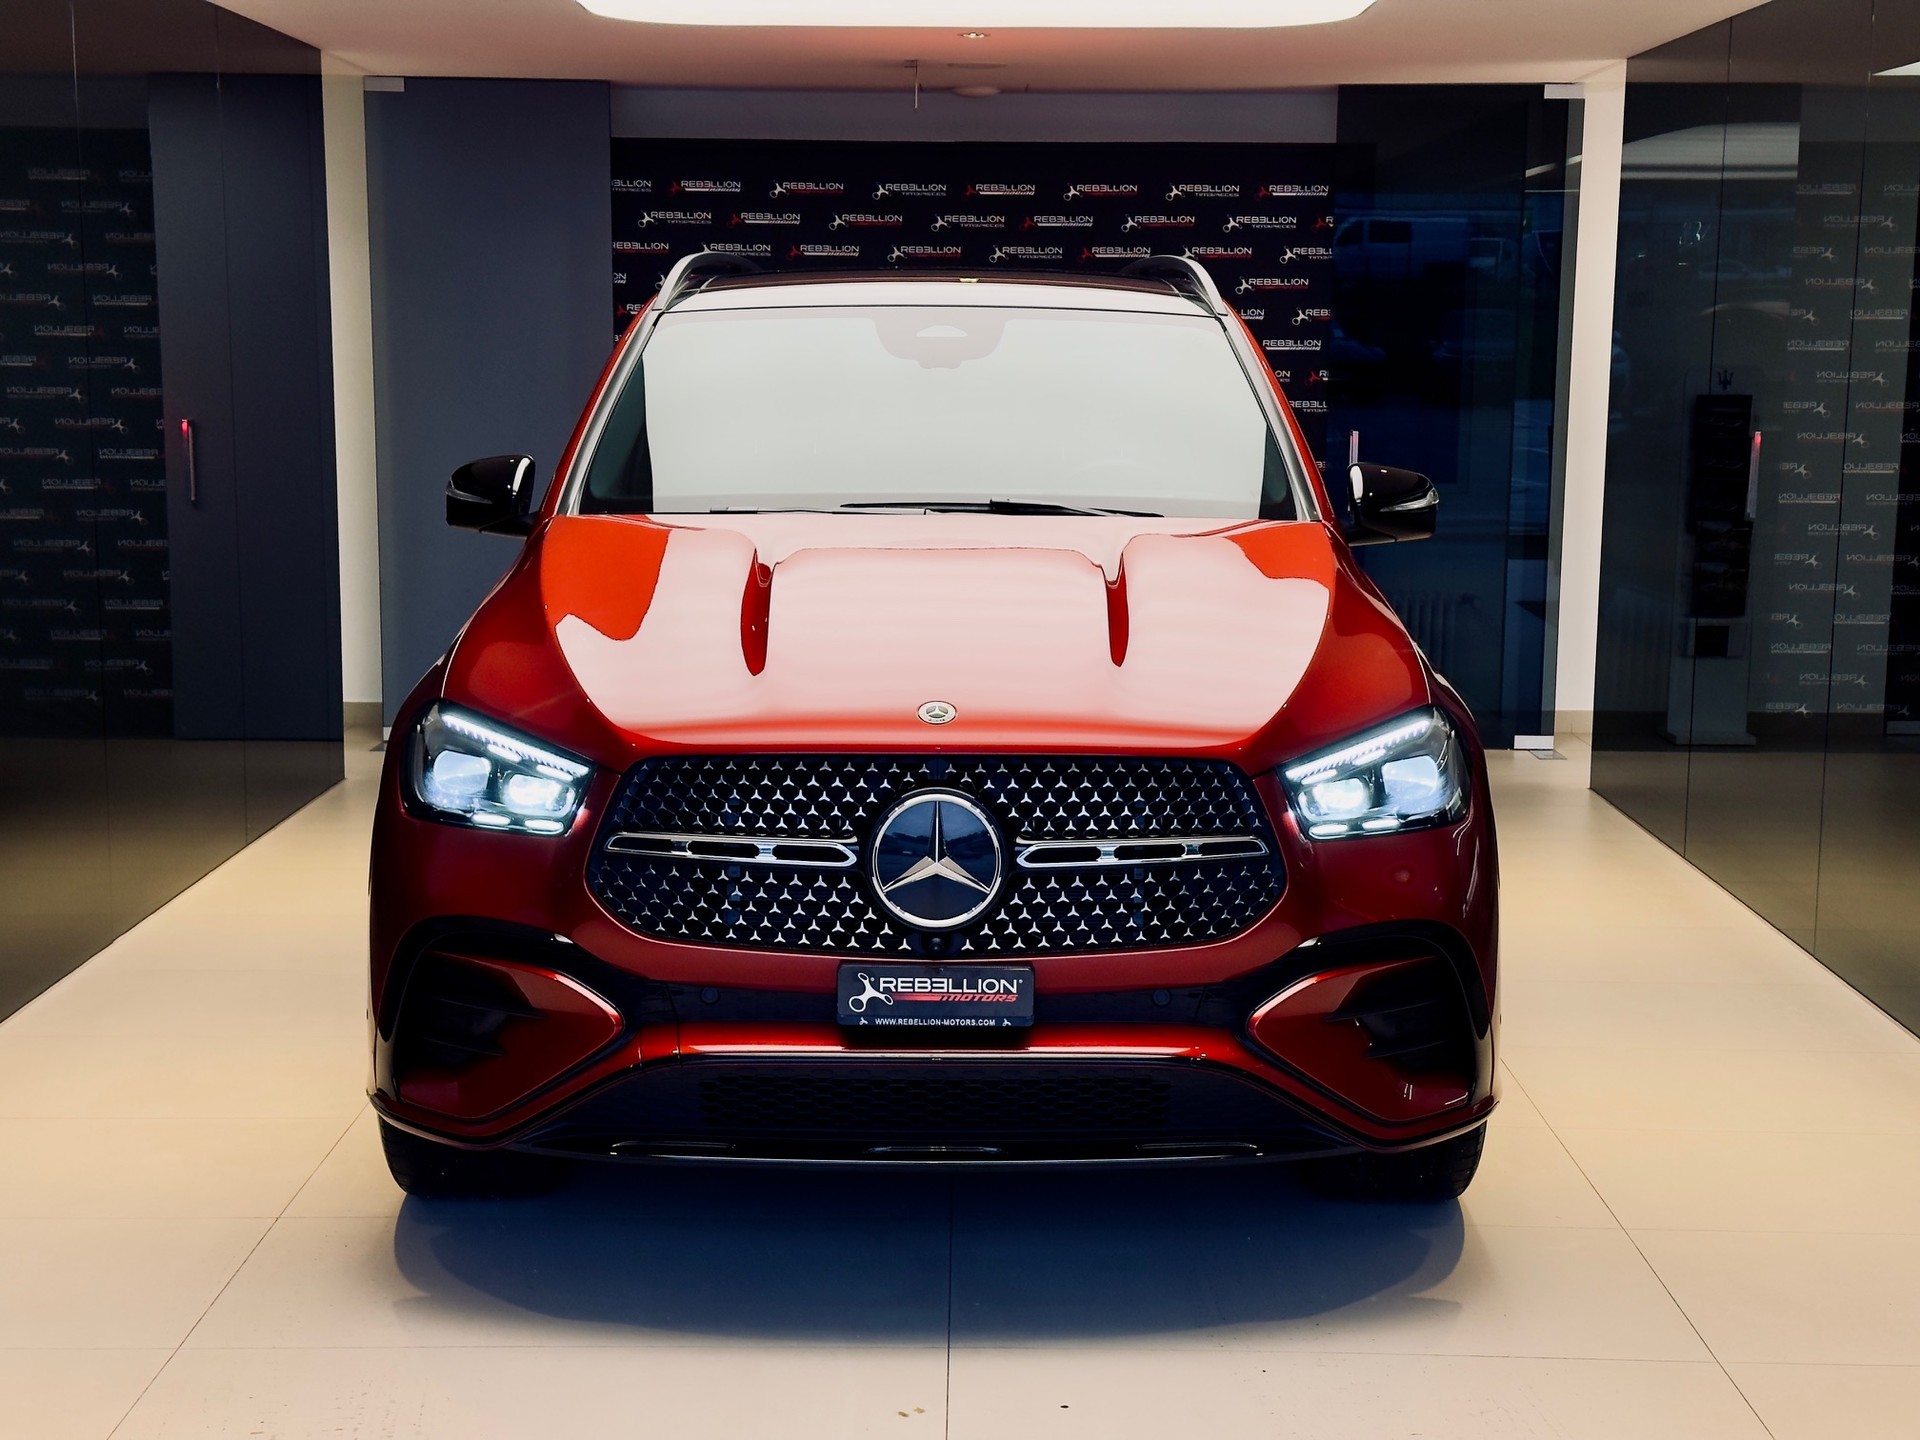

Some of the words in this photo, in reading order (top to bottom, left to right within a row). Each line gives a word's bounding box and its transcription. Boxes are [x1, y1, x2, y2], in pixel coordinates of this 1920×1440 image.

[783, 182, 844, 190] REBELLION
[885, 183, 946, 191] REBELLION
[1077, 184, 1138, 192] REBELLION
[1179, 184, 1240, 192] REBELLION
[650, 211, 712, 219] REBELLION
[842, 214, 903, 222] REBELLION
[944, 215, 1005, 223] REBELLION
[1236, 216, 1297, 224] REBELLION
[710, 243, 771, 251] REBELLION
[900, 246, 961, 254] REBELLION
[1002, 246, 1063, 254] REBELLION
[1293, 247, 1333, 255] REBELL
[1248, 278, 1309, 286] REBELLION
[879, 977, 1017, 994] REBELLION
[875, 1018, 996, 1026] WWW.REBELLION-MOTORS.COM
